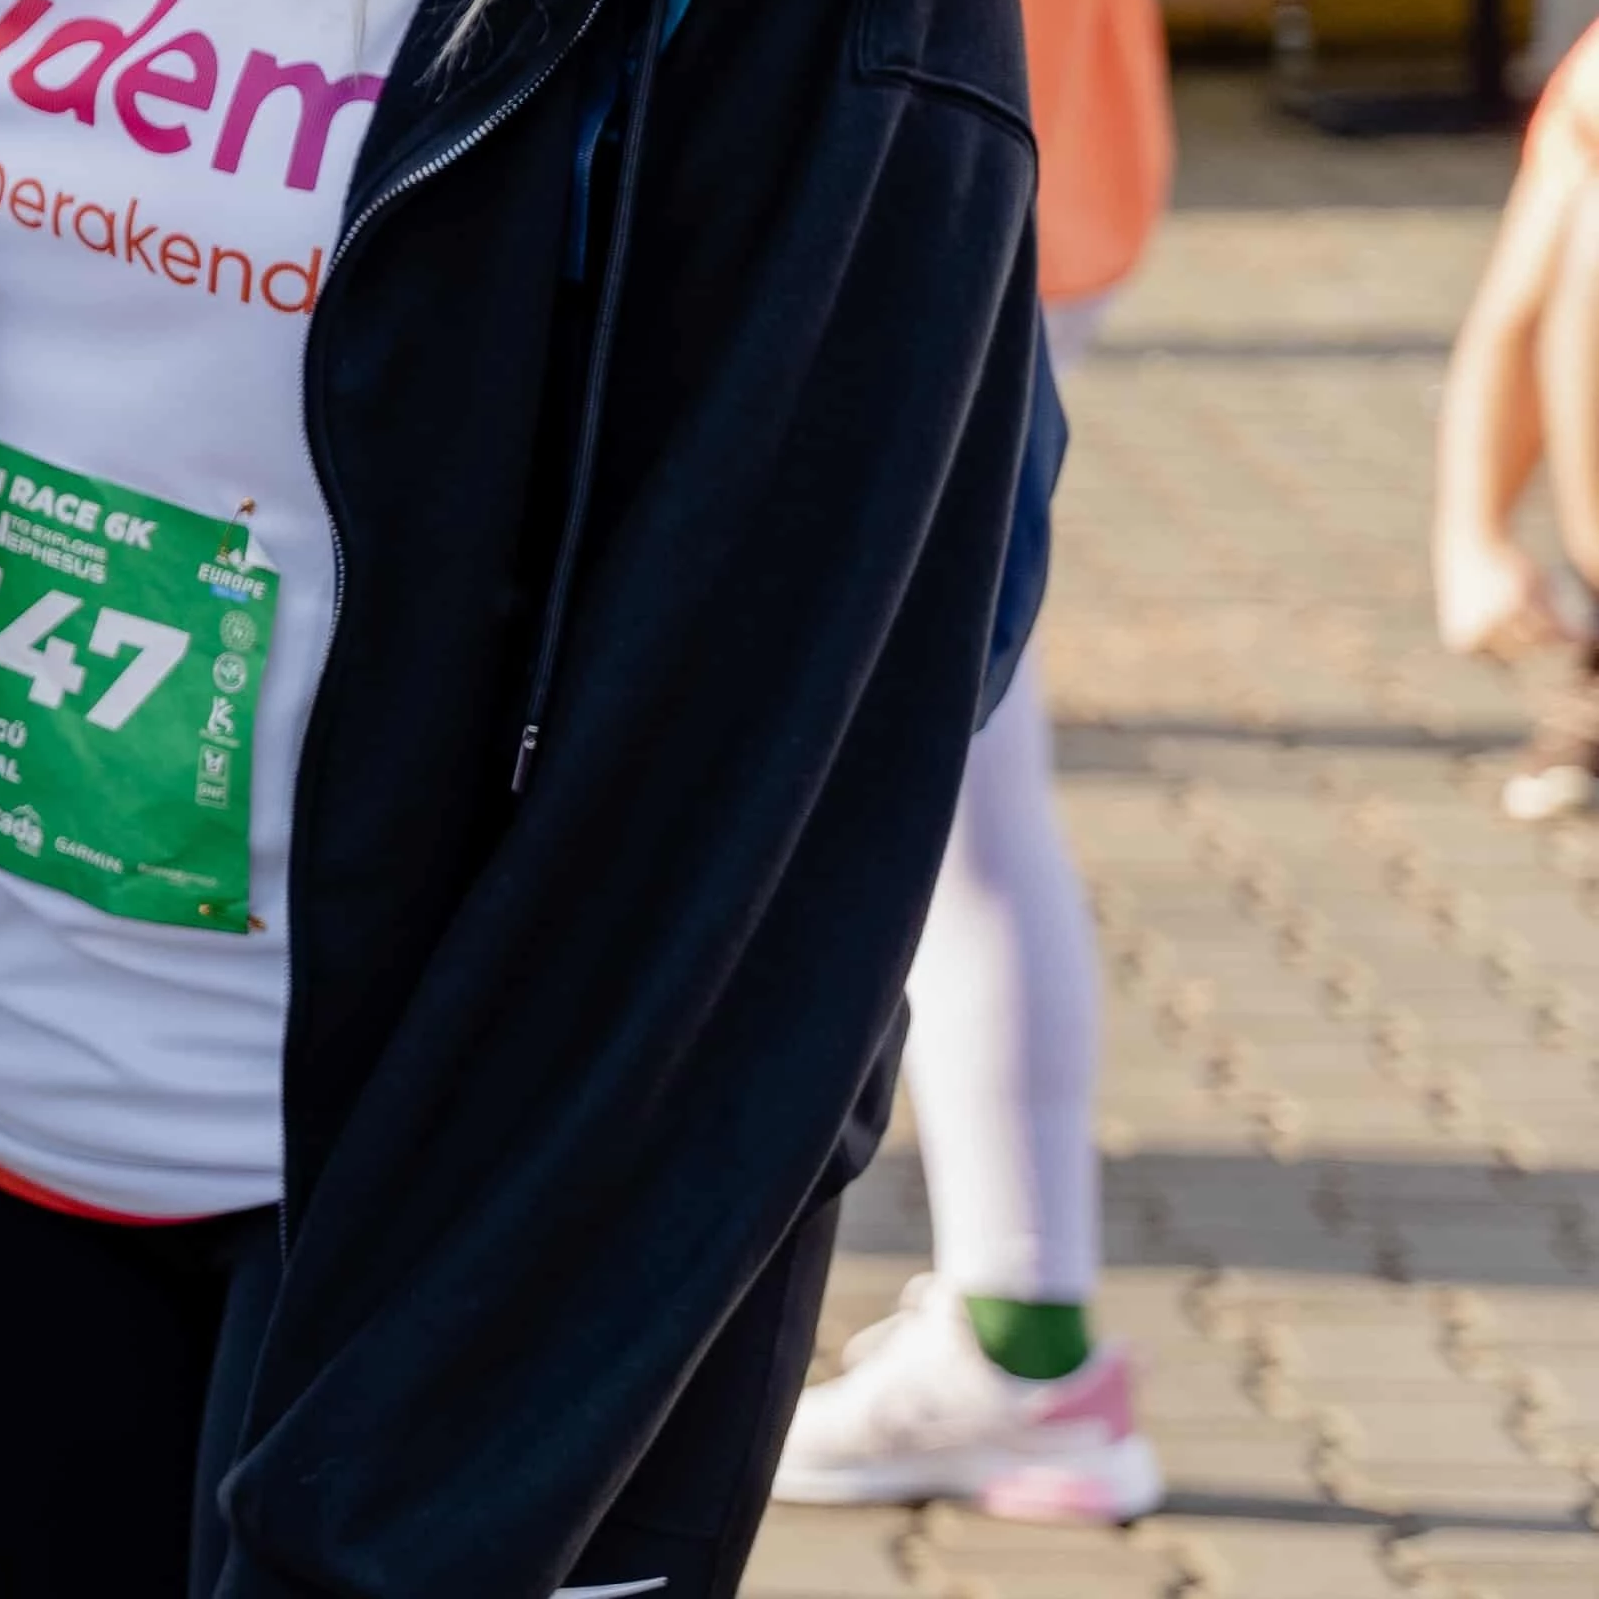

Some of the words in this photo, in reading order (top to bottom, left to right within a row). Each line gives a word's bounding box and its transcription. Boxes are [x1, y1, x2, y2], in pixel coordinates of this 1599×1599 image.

[9, 474, 101, 534] RACE
[104, 512, 159, 551] 6K
[3, 529, 108, 584] EPHESUS
[197, 561, 268, 600] EUROPE
